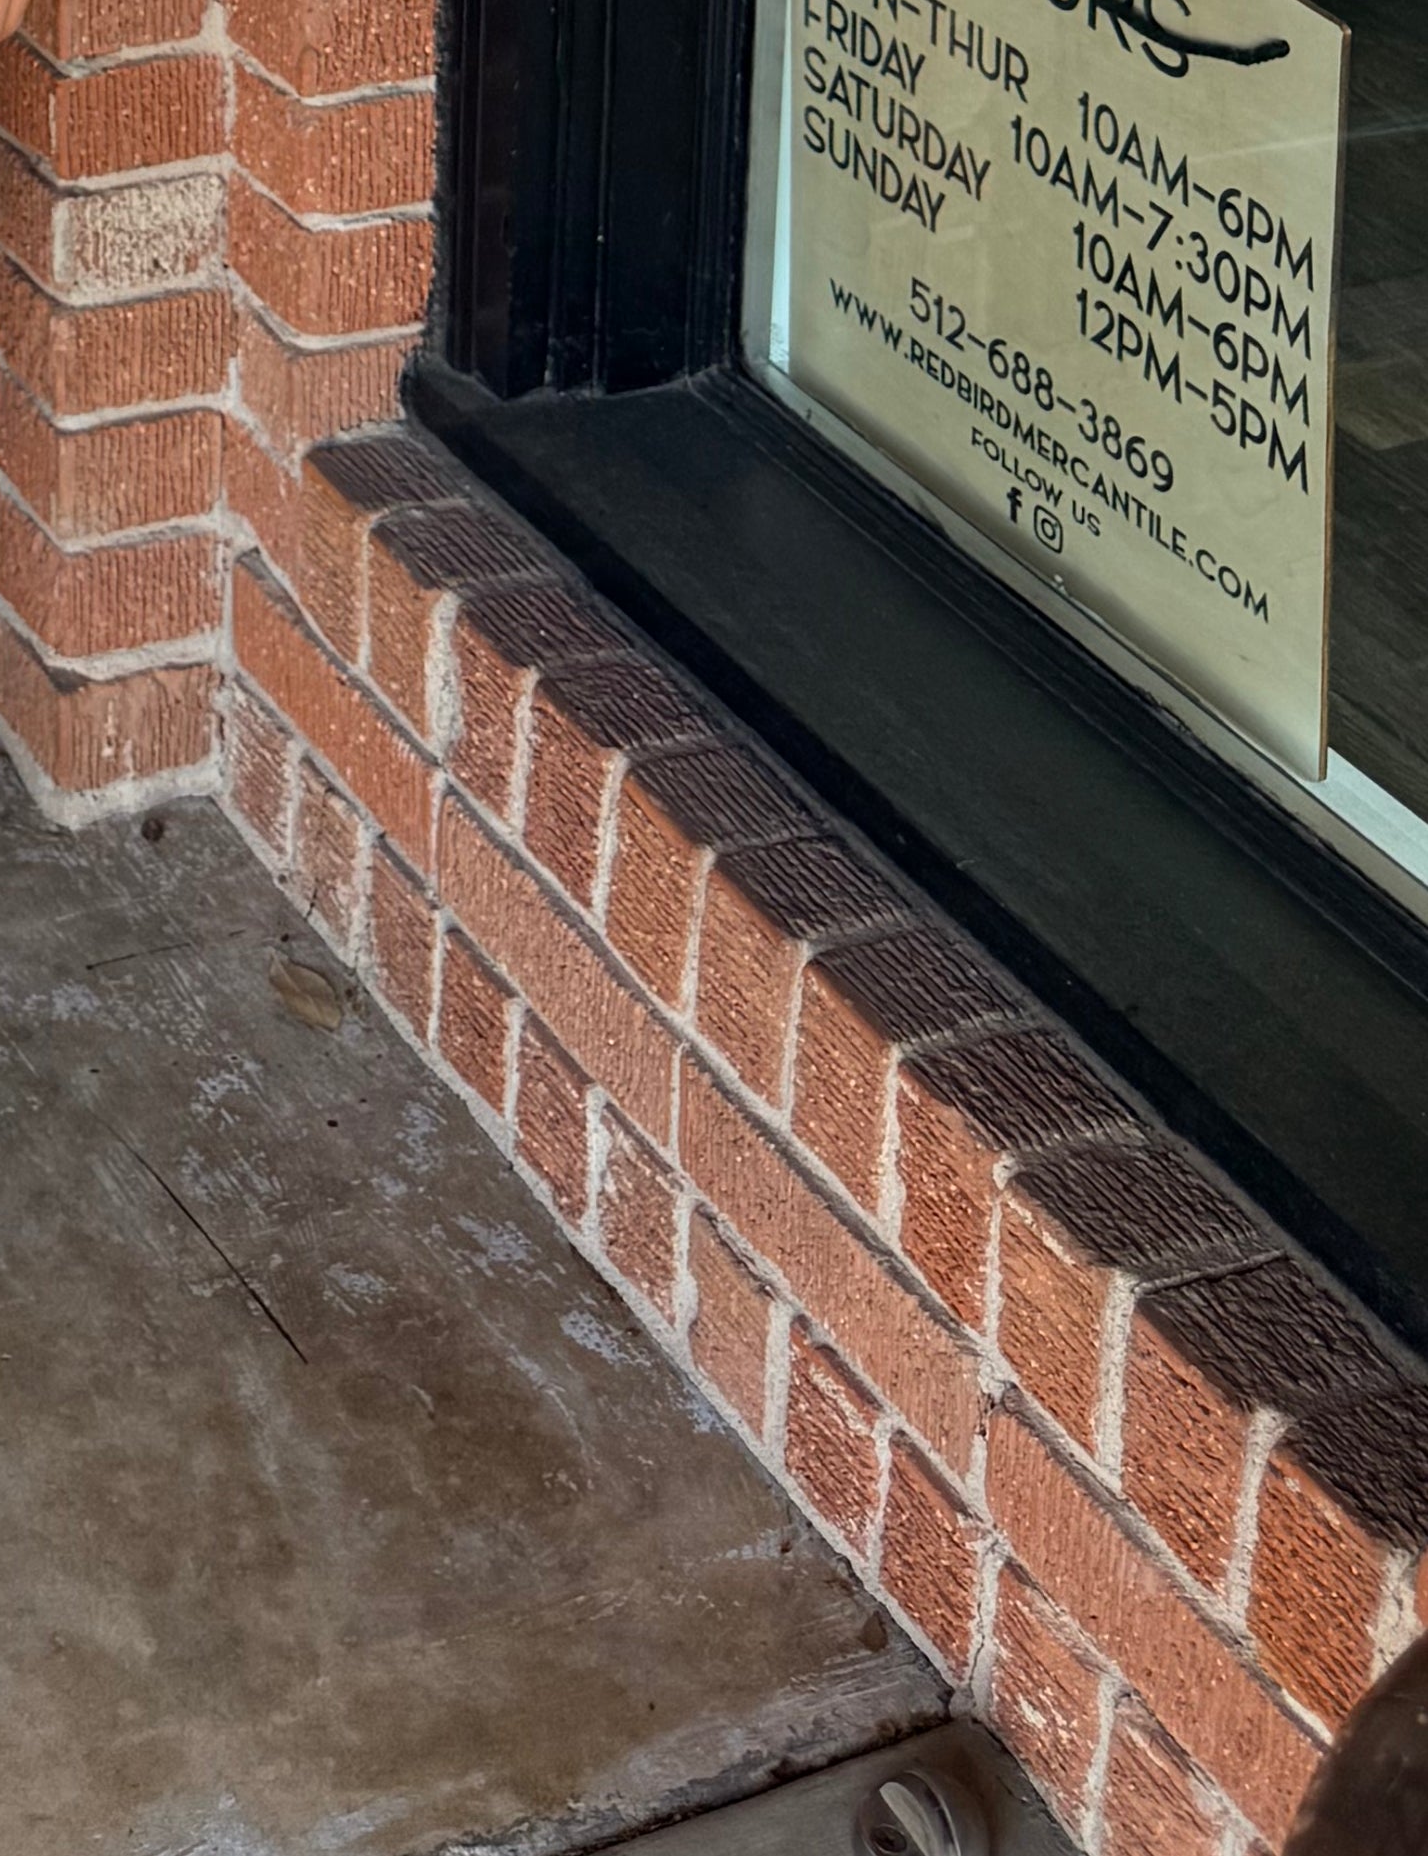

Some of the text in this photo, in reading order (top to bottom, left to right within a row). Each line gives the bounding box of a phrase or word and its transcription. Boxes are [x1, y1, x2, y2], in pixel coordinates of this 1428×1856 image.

[804, 46, 1310, 428] SATURDAY 10AM-6PM
[804, 105, 1309, 495] SUNDAY 12PM-5PM
[1011, 115, 1311, 360] 10AM-7:30PM
[1077, 91, 1314, 292] 10AM-6PM
[830, 277, 1269, 624] WWW.REDBIRDMERCANTILE.COM
[910, 277, 1174, 493] 512-688-3869
[971, 426, 1101, 537] FOLLOW US
